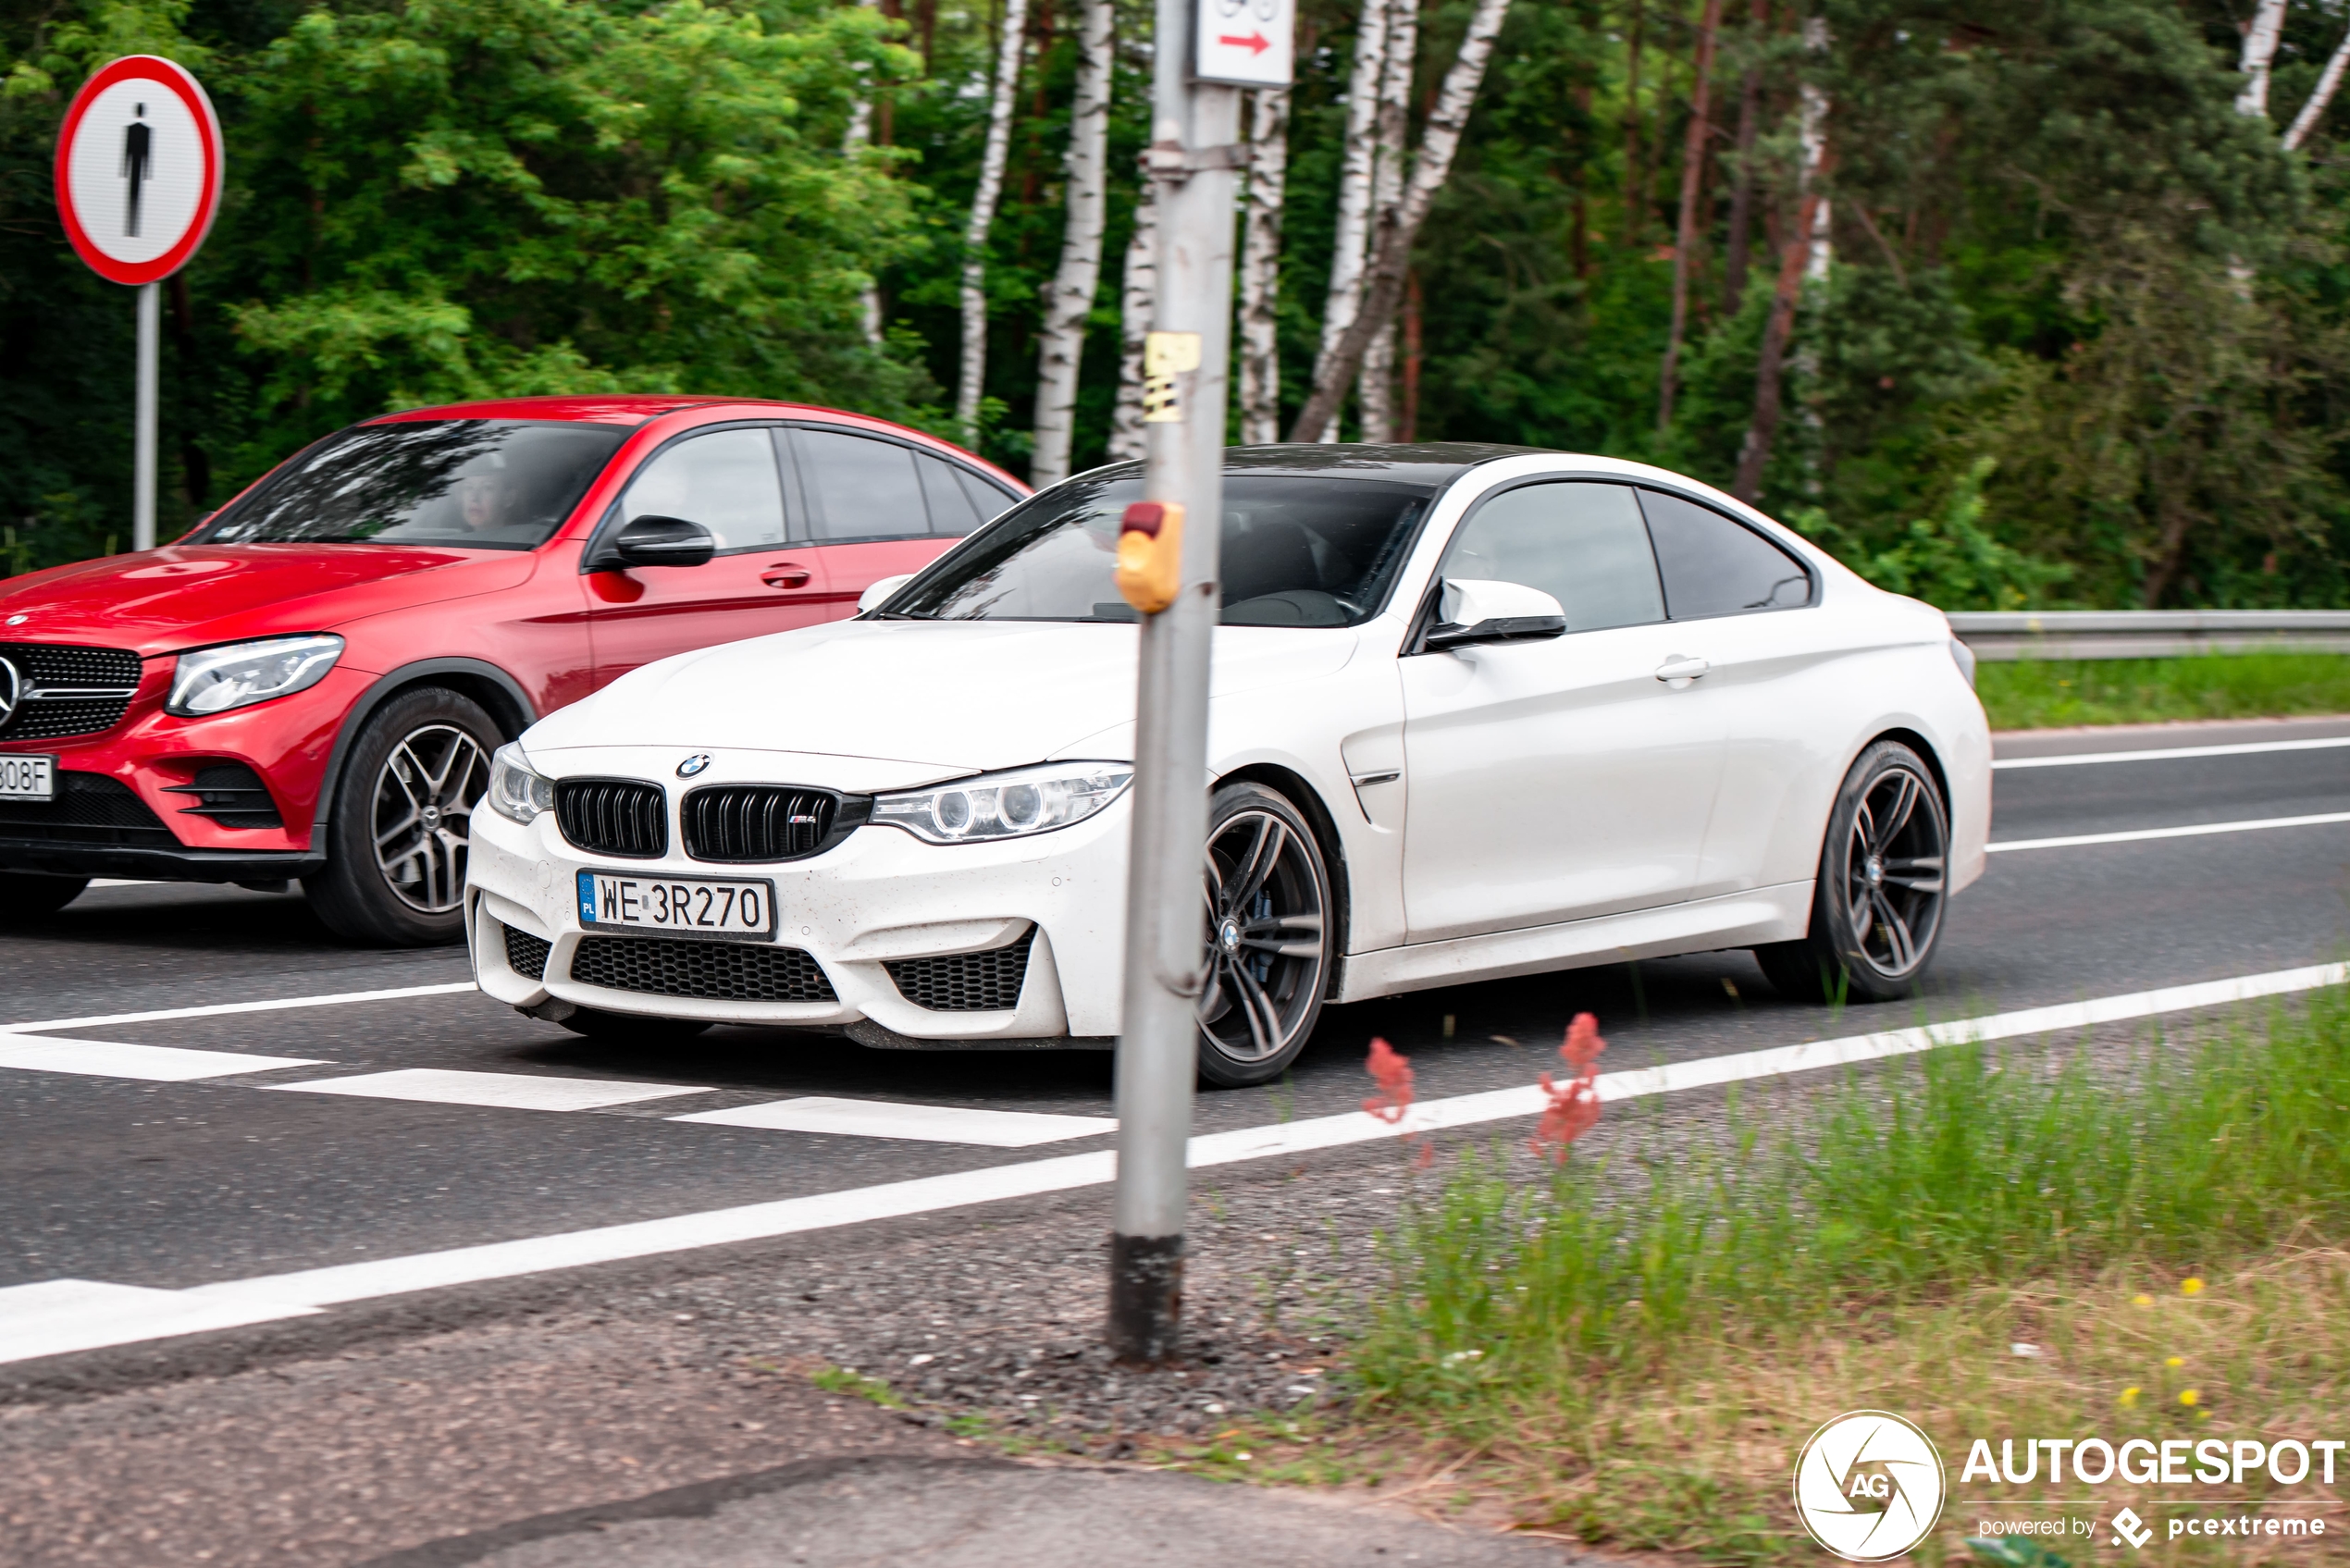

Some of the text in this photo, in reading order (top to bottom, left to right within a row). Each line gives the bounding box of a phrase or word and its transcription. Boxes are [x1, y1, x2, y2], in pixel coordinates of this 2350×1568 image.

[583, 902, 595, 914] PL
[600, 880, 760, 928] WE 3R270
